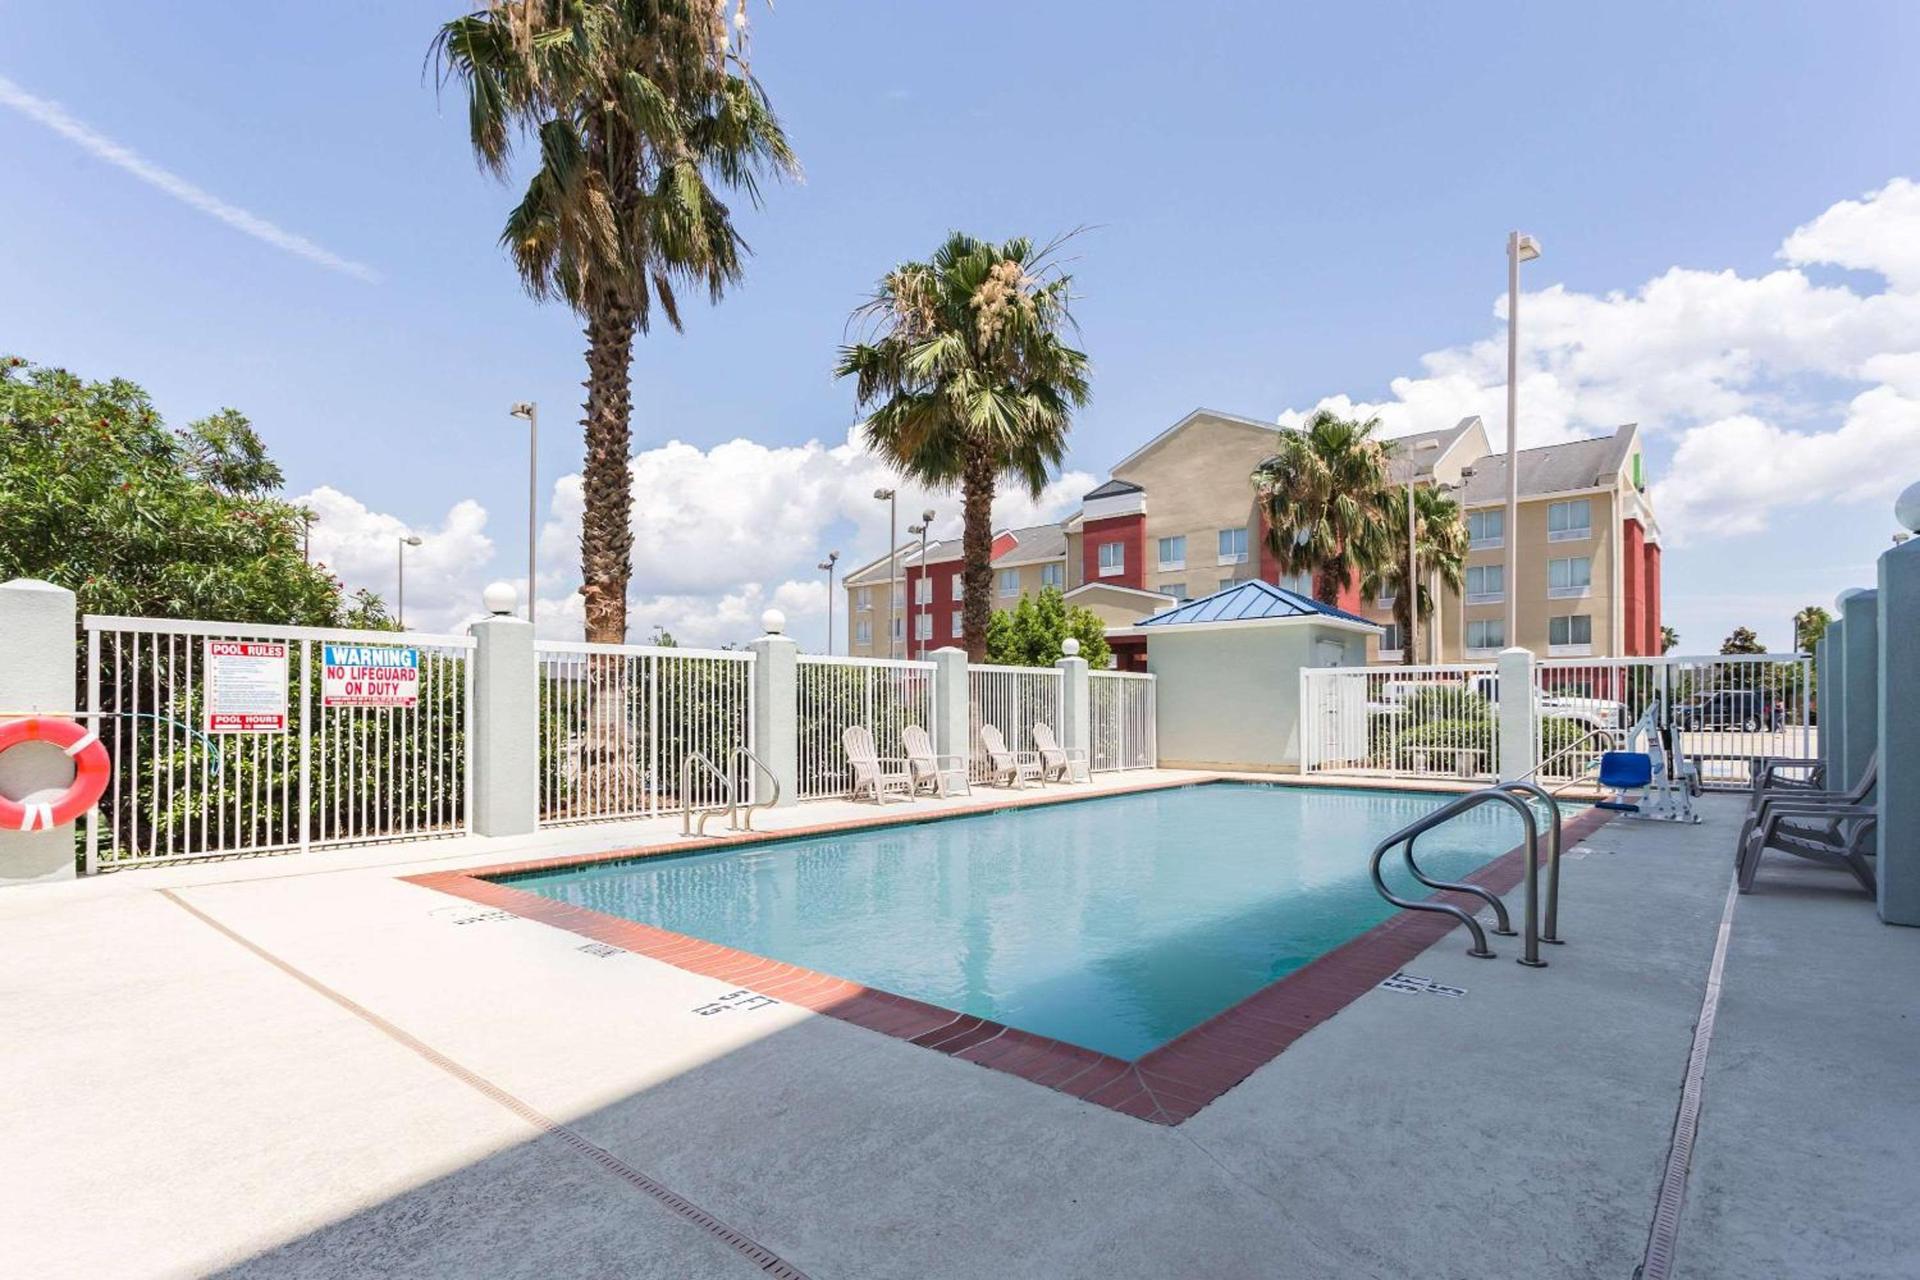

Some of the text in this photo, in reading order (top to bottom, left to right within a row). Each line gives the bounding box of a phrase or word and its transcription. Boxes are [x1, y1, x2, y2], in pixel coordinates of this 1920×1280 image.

[213, 644, 282, 657] POOL RULES
[331, 647, 412, 667] WARNING
[327, 667, 416, 681] NO LIFEGUARD
[345, 682, 399, 696] ON DUTY
[734, 995, 780, 1011] FT
